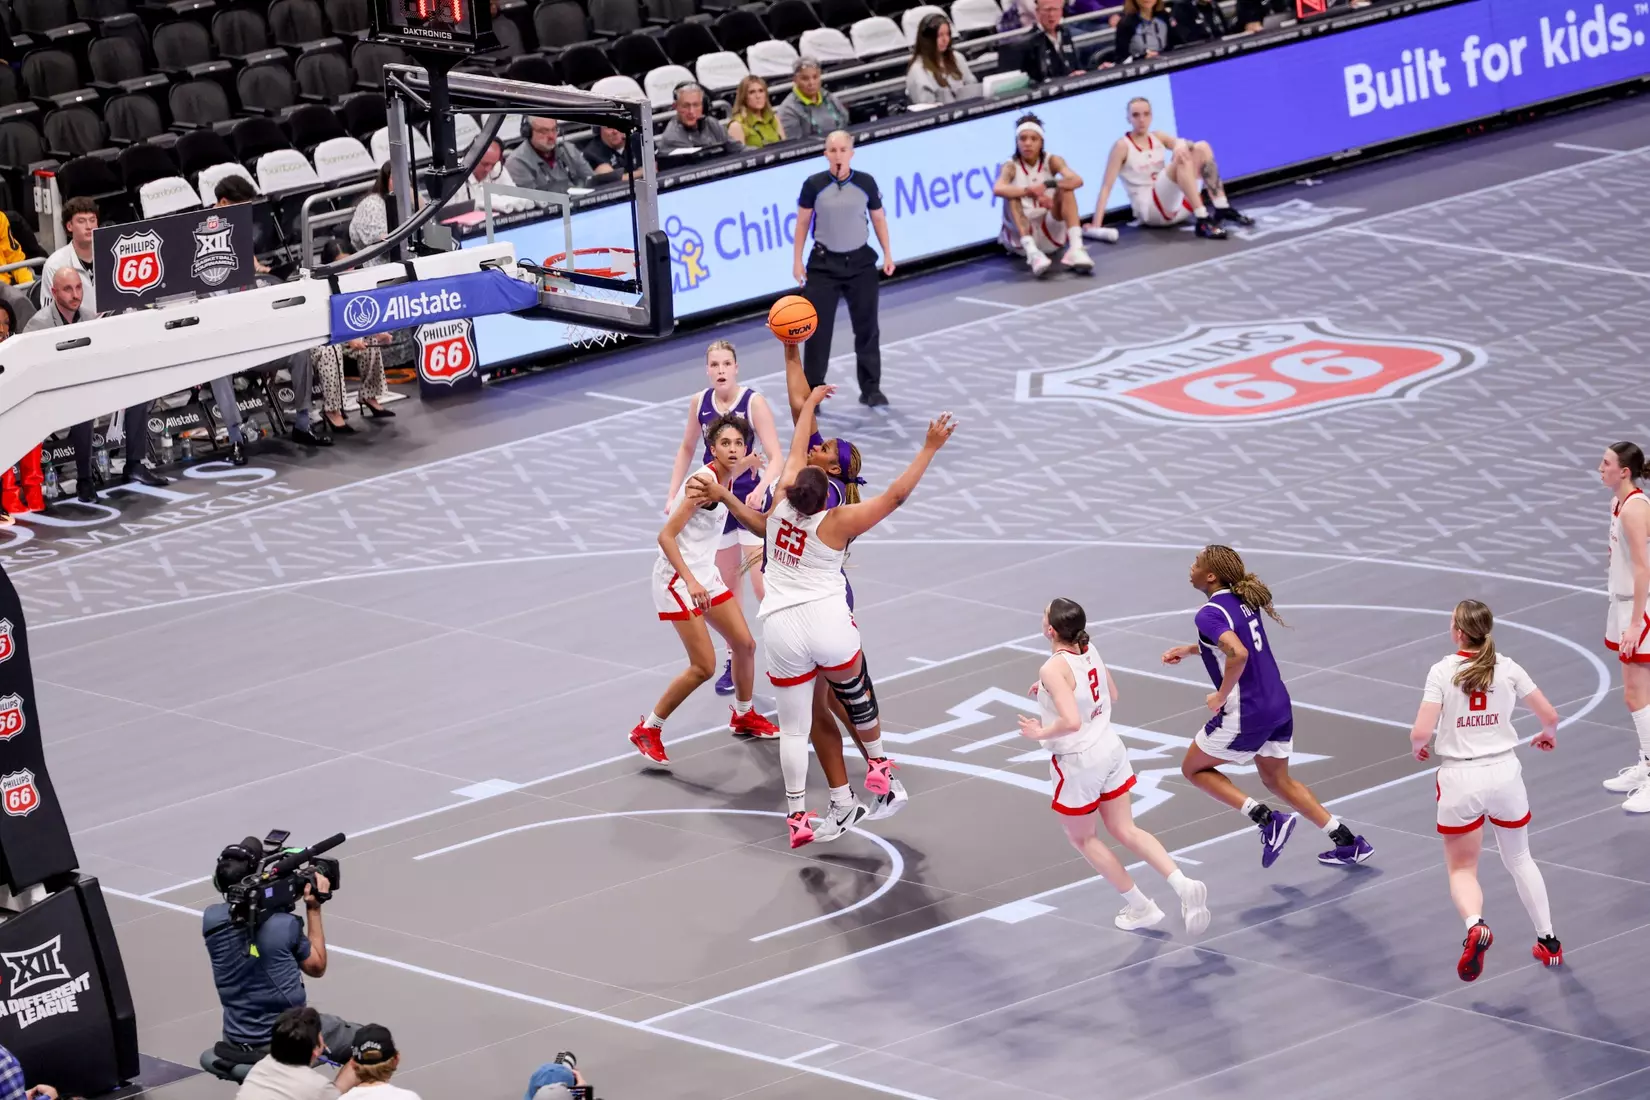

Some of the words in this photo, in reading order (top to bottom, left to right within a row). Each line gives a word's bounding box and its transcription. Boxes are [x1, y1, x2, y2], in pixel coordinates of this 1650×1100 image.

[403, 27, 452, 40] DAKTRONICS
[1344, 47, 1451, 118] Built
[1461, 34, 1527, 88] for
[895, 163, 1002, 219] Mercy
[119, 239, 155, 255] PHILLIPS
[196, 228, 232, 258] XII
[122, 256, 154, 283] 66
[193, 261, 235, 273] TOURNAMENT
[195, 255, 235, 268] BASKETBALL
[382, 289, 462, 323] Allstate
[423, 322, 464, 342] PHILLIPS
[788, 323, 811, 336] NCAA
[430, 341, 463, 372] 66
[1066, 331, 1296, 392] PHILLIPS
[1182, 349, 1384, 408] 66
[236, 397, 263, 412] lstate
[165, 412, 200, 429] Allstate
[56, 482, 303, 549] MARKET
[775, 518, 808, 557] 23
[773, 548, 801, 568] MALONE
[1248, 618, 1263, 652] 5
[1088, 667, 1100, 703] 2
[1456, 713, 1499, 728] BLACKLOCK
[3, 774, 30, 789] PHILLIPS
[9, 788, 31, 808] 66
[7, 971, 90, 1014] DIFFERENT
[17, 994, 79, 1029] LEAGUE
